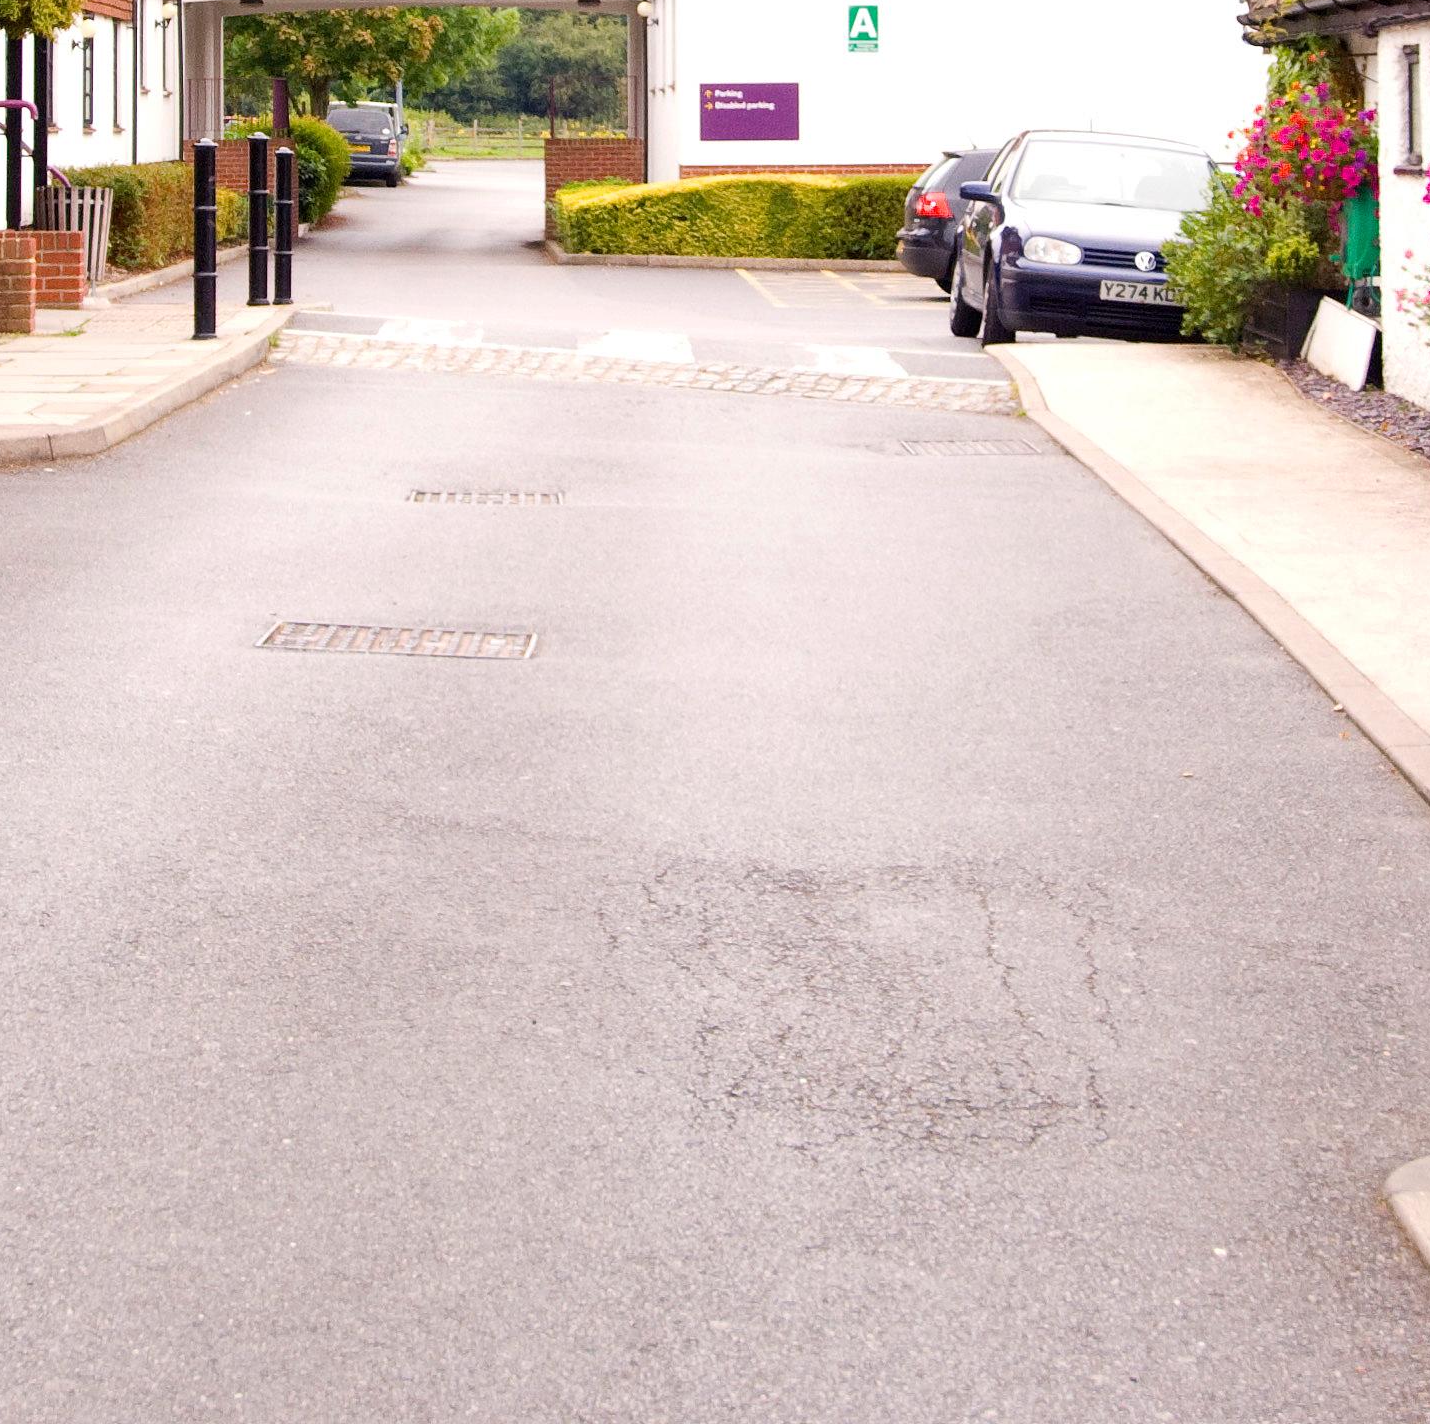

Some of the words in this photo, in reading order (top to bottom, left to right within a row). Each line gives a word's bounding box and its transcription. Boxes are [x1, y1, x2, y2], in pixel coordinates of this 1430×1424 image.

[849, 7, 877, 38] A
[714, 89, 743, 99] Parking
[1104, 282, 1148, 301] Y274
